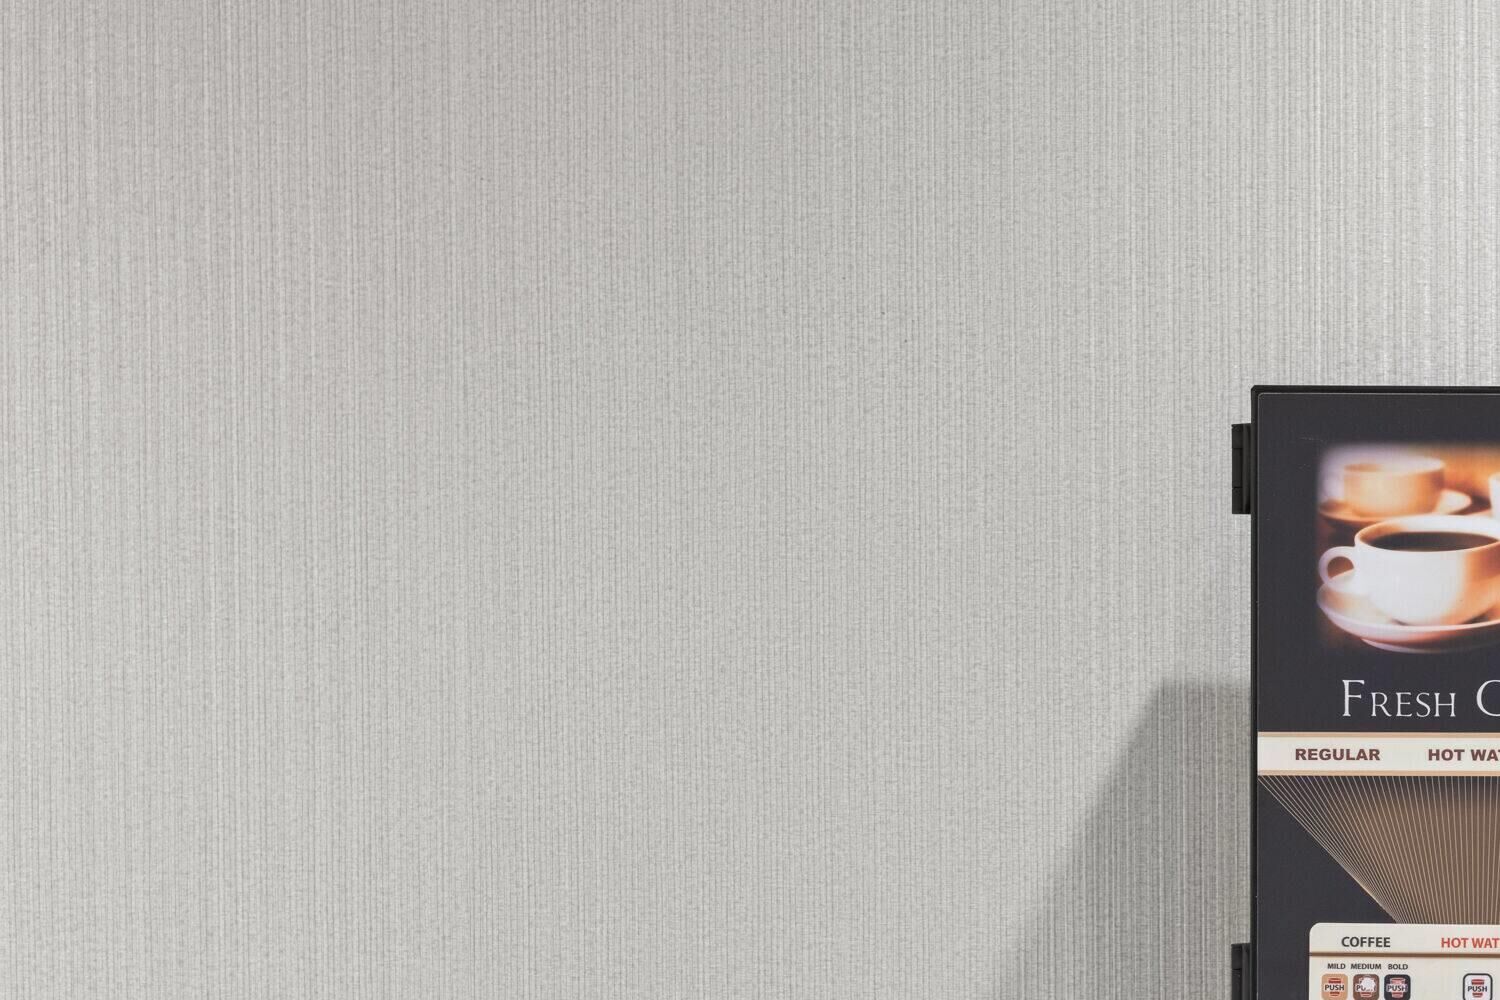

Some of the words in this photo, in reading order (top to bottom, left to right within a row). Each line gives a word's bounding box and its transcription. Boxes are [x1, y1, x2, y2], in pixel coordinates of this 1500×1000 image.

[1295, 748, 1381, 761] REGULAR
[1428, 748, 1464, 762] HOT
[1341, 936, 1391, 948] COFFEE
[1440, 937, 1470, 949] HOT
